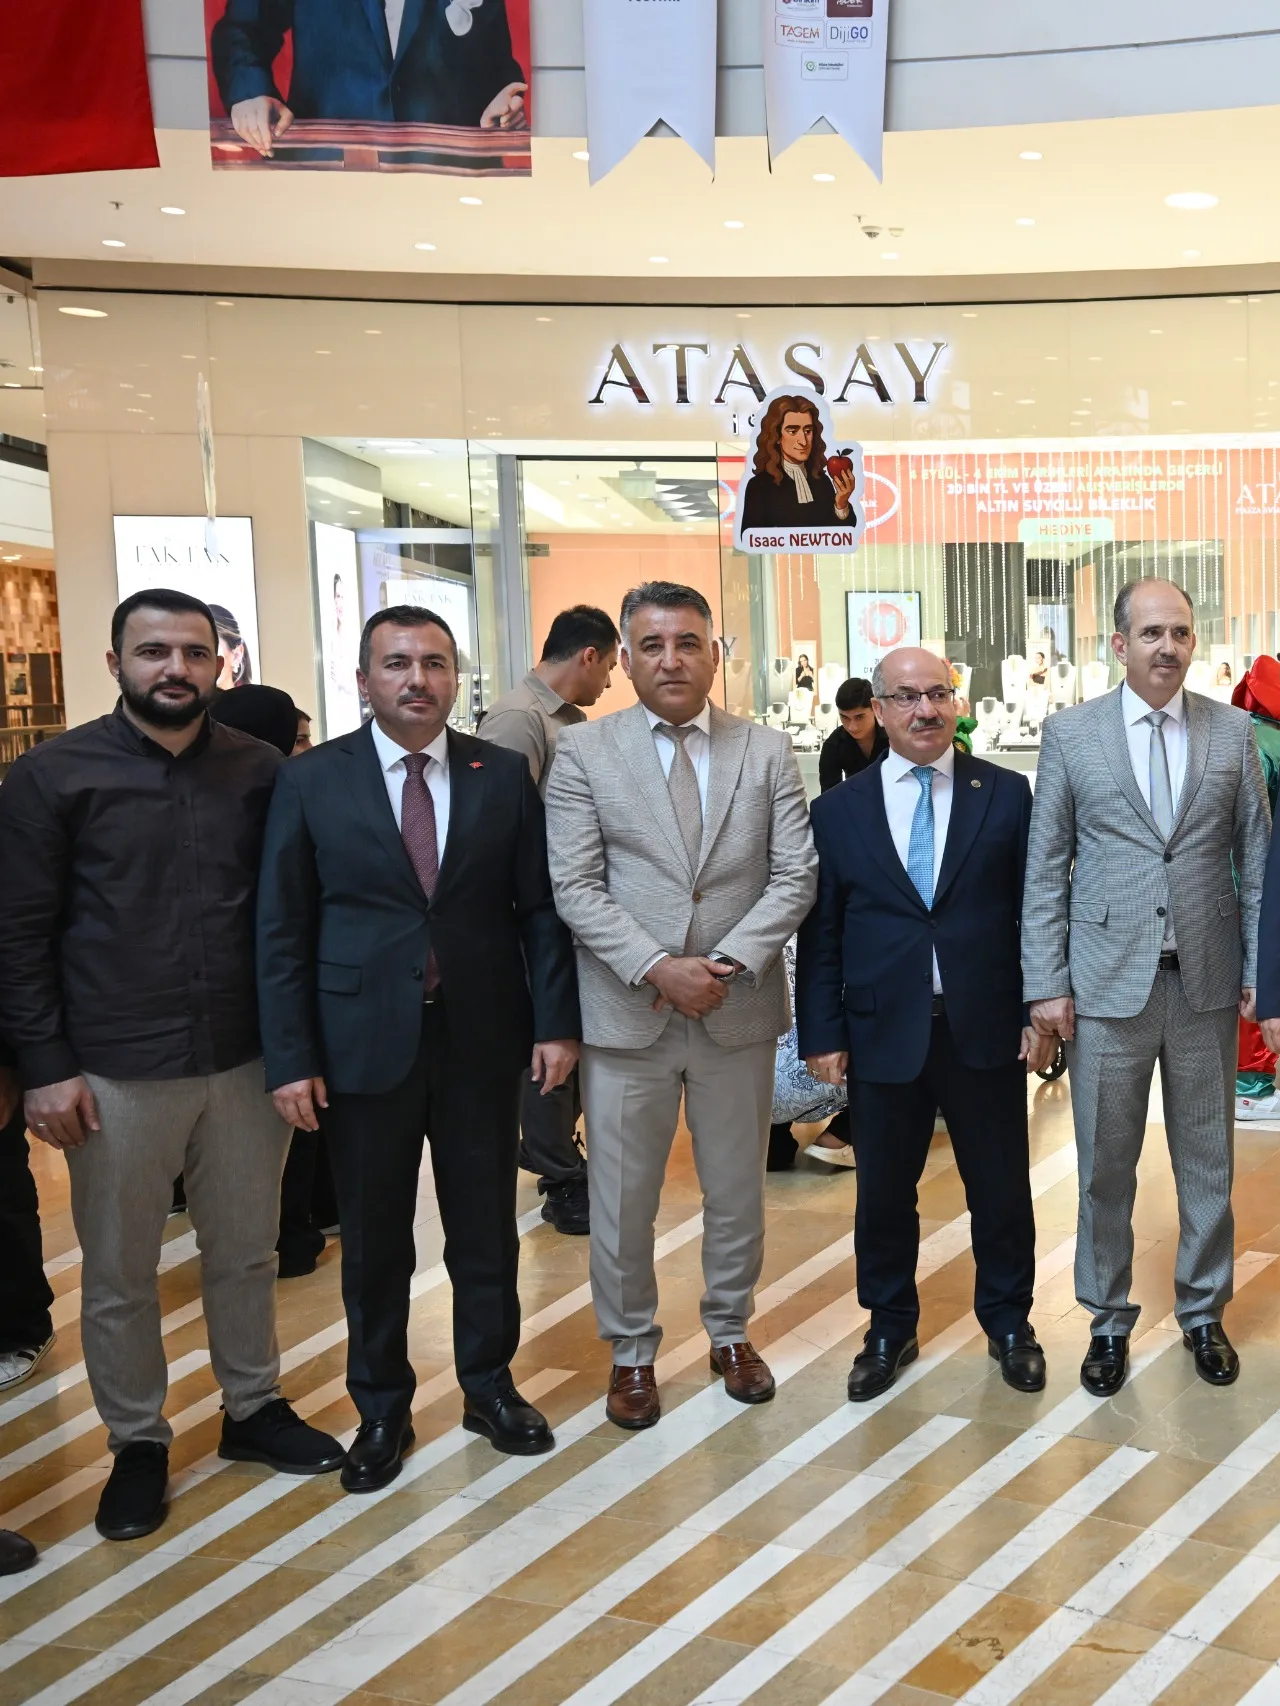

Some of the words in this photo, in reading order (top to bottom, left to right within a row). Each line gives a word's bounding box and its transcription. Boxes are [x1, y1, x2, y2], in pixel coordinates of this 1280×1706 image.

[780, 24, 820, 39] TAGEM
[829, 25, 869, 43] DijiGO
[587, 341, 948, 405] ATASAY
[1039, 521, 1093, 536] HEDİYE
[749, 534, 785, 548] Isaac
[789, 532, 853, 547] NEWTON
